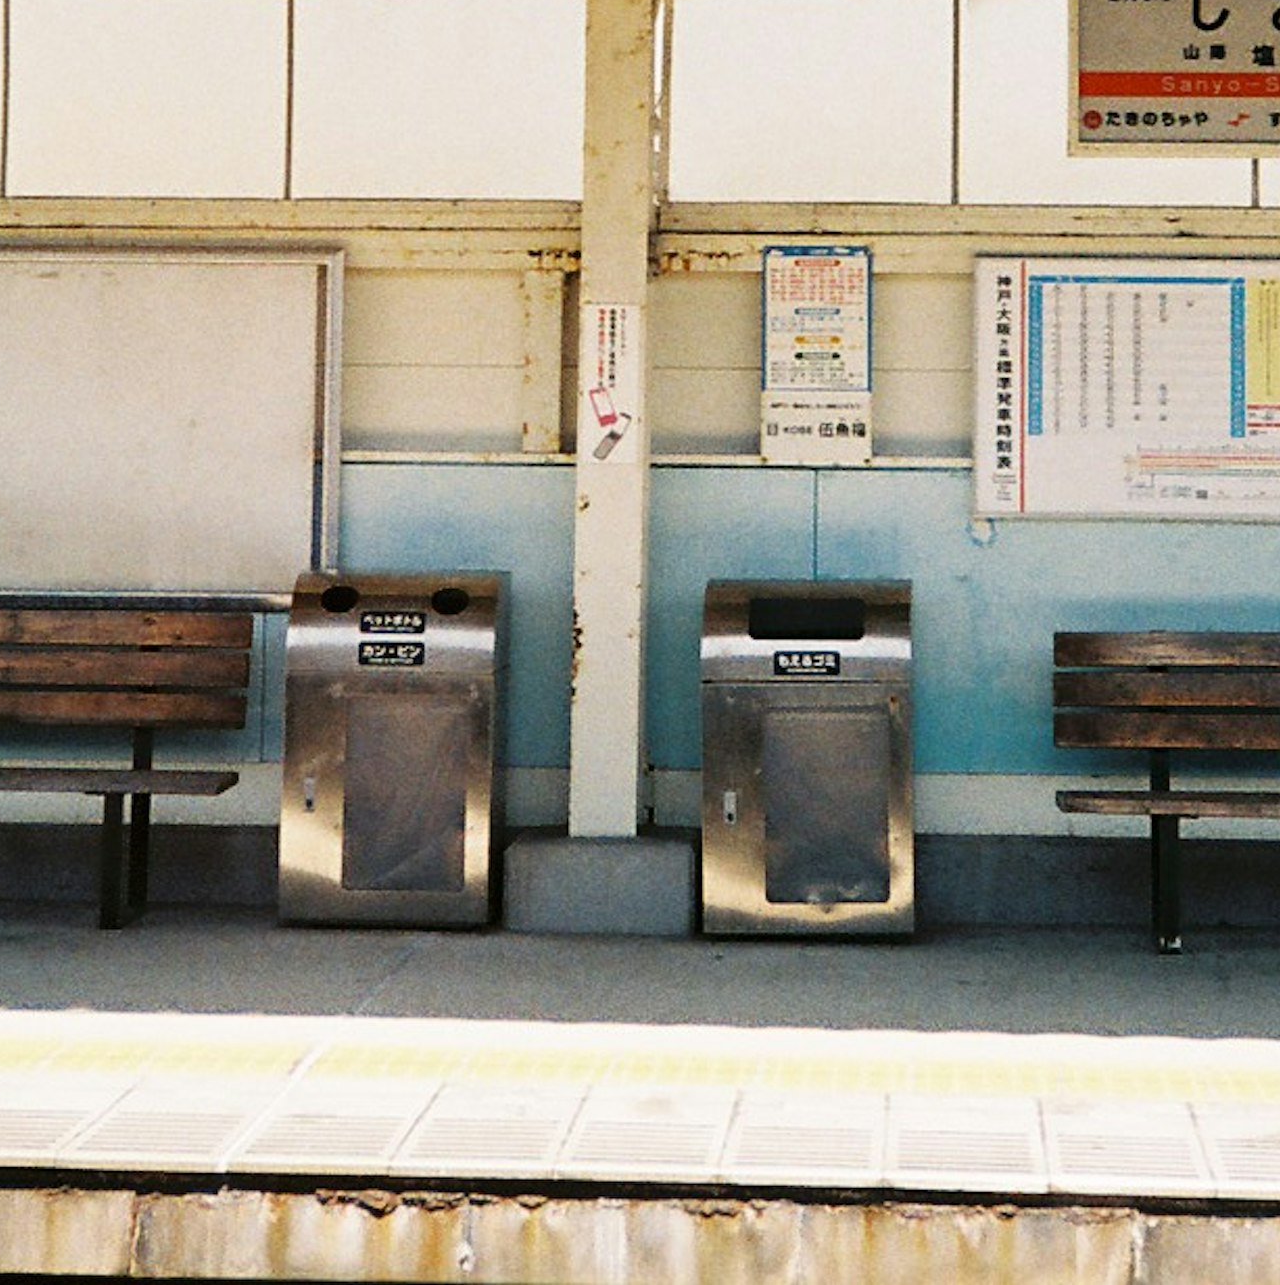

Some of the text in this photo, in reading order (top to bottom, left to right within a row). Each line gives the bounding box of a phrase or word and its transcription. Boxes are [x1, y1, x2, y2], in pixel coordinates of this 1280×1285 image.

[1105, 111, 1208, 126] たきのちゃや
[363, 614, 422, 626] ペットボトル
[362, 645, 421, 658] カン・ビン
